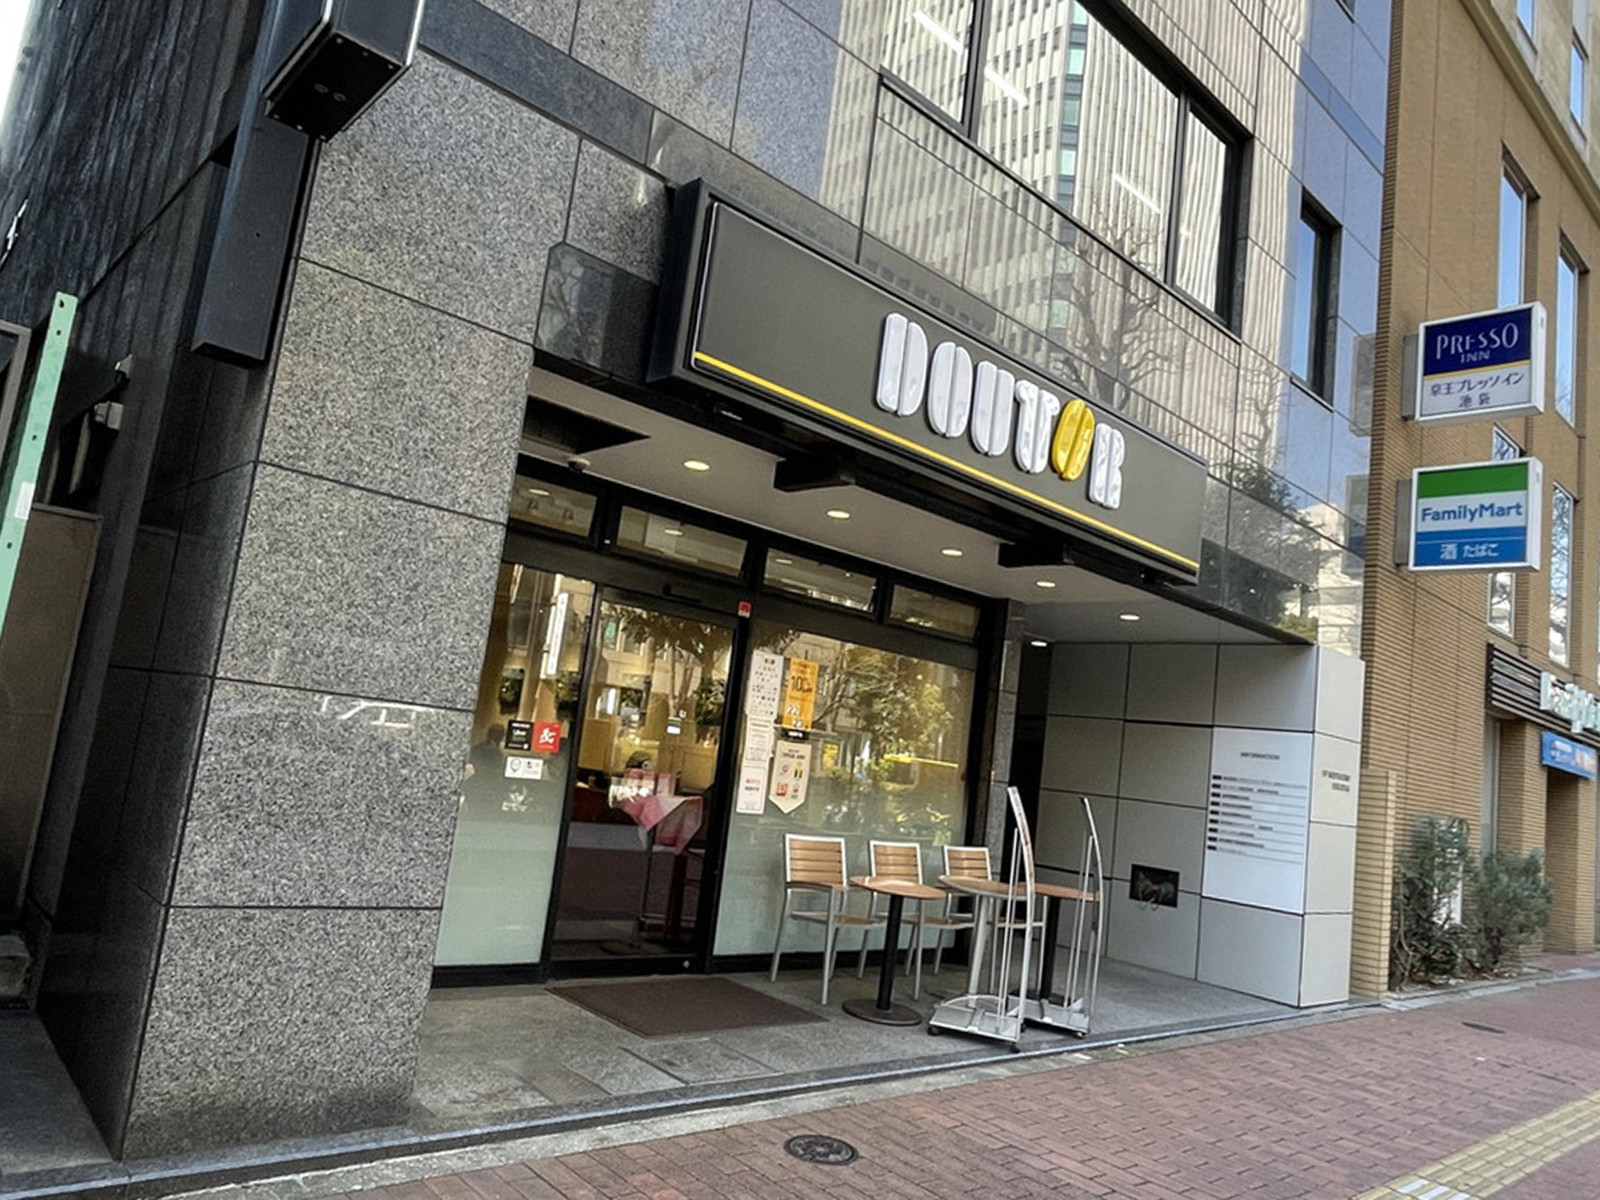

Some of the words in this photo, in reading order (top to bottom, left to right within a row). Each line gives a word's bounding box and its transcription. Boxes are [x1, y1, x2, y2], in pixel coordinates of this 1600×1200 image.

[1435, 322, 1519, 360] PRESSO
[1460, 350, 1491, 364] INN
[876, 312, 1126, 510] DOUTOR
[1420, 502, 1524, 522] FamilyMart
[1439, 543, 1458, 560] 酒
[1463, 543, 1499, 558] たばこ
